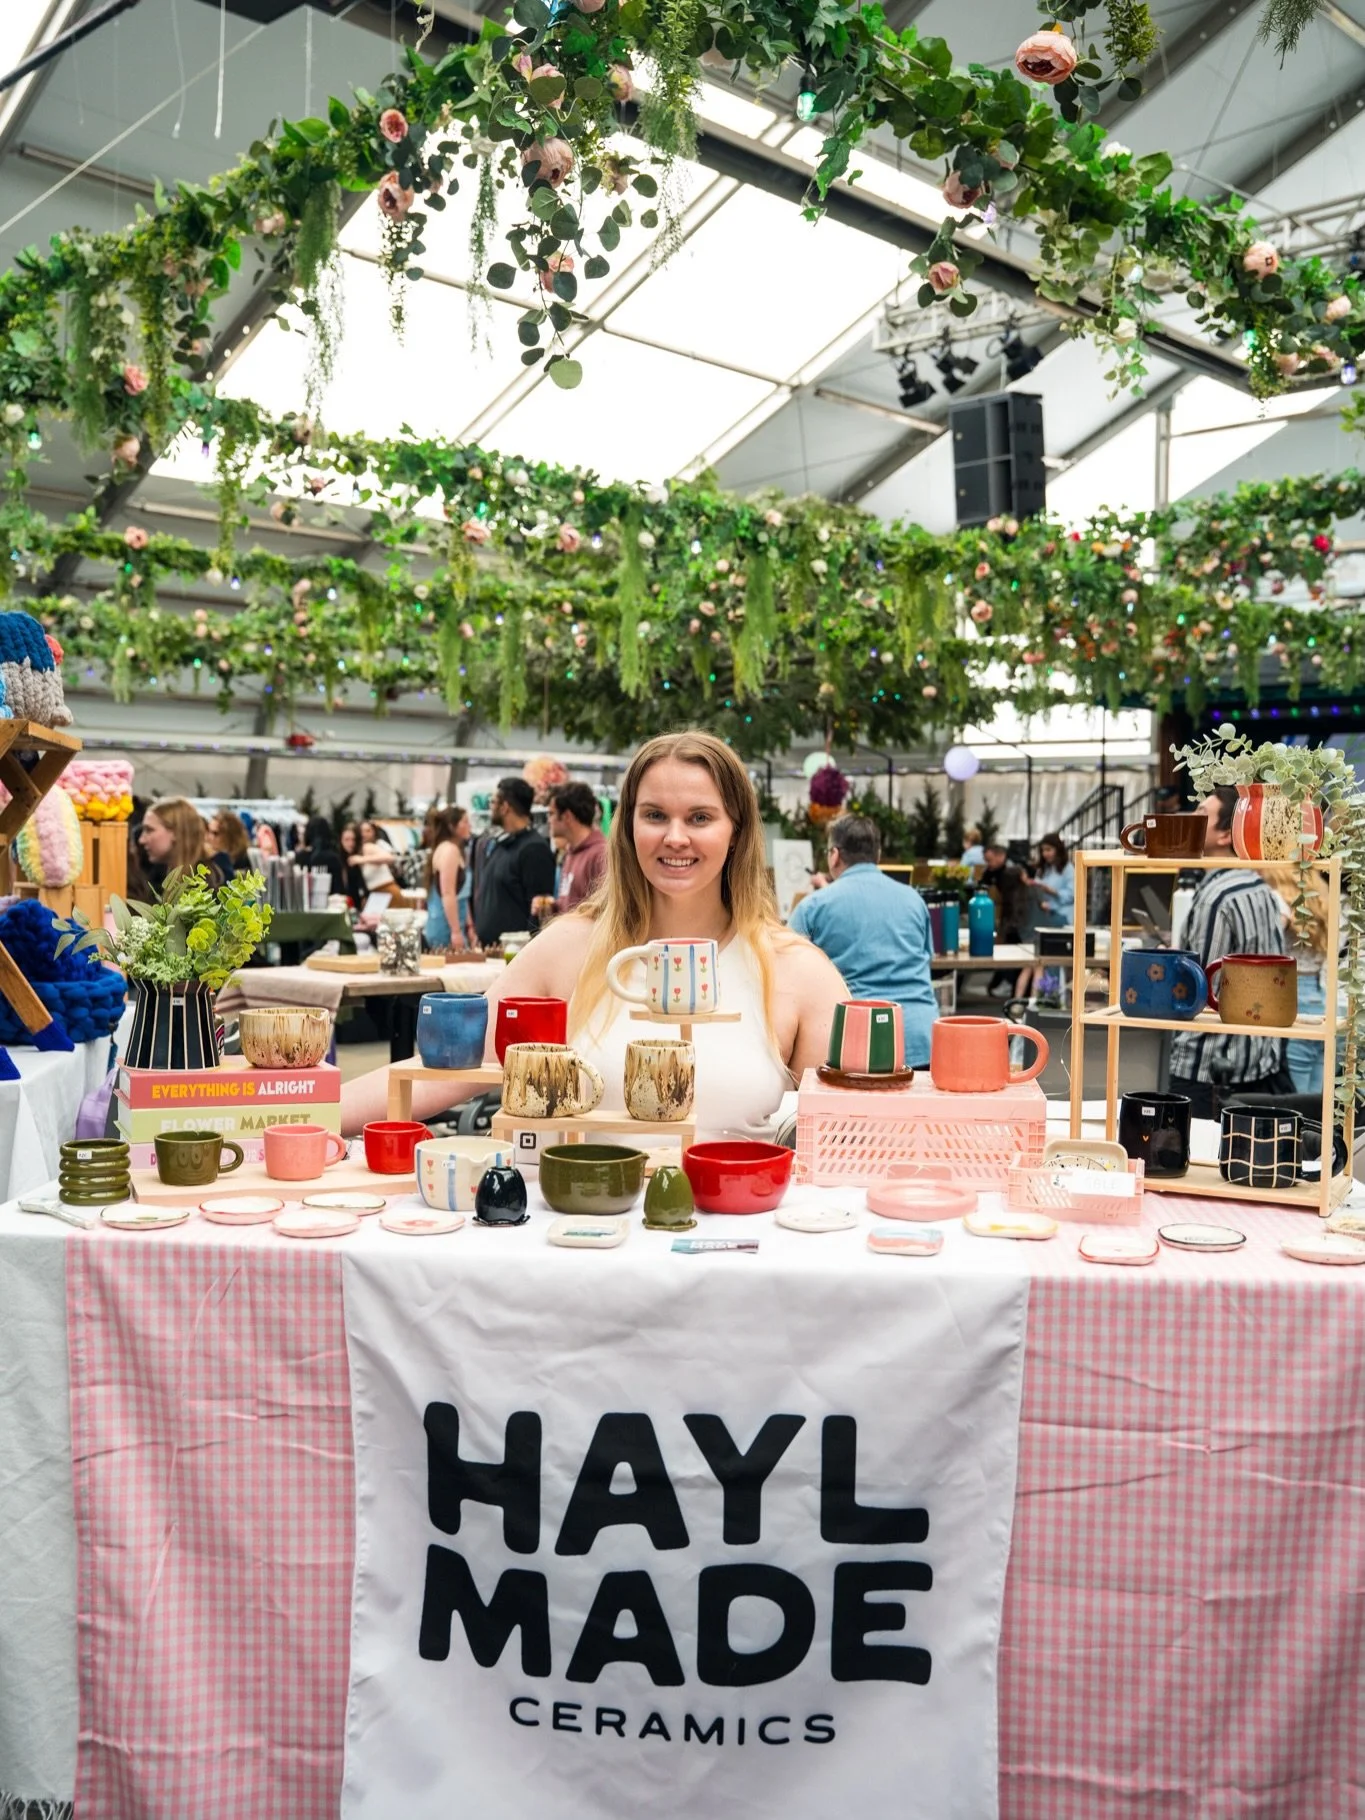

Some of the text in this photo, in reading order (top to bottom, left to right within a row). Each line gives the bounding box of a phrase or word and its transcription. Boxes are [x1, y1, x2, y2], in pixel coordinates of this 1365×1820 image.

[152, 1080, 316, 1099] EVERYTHING IS ALRIGHT
[160, 1113, 311, 1132] FLOWER MARKET
[422, 1401, 930, 1557] HAYL
[418, 1543, 934, 1688] MADE
[509, 1696, 837, 1746] CERAMICS
